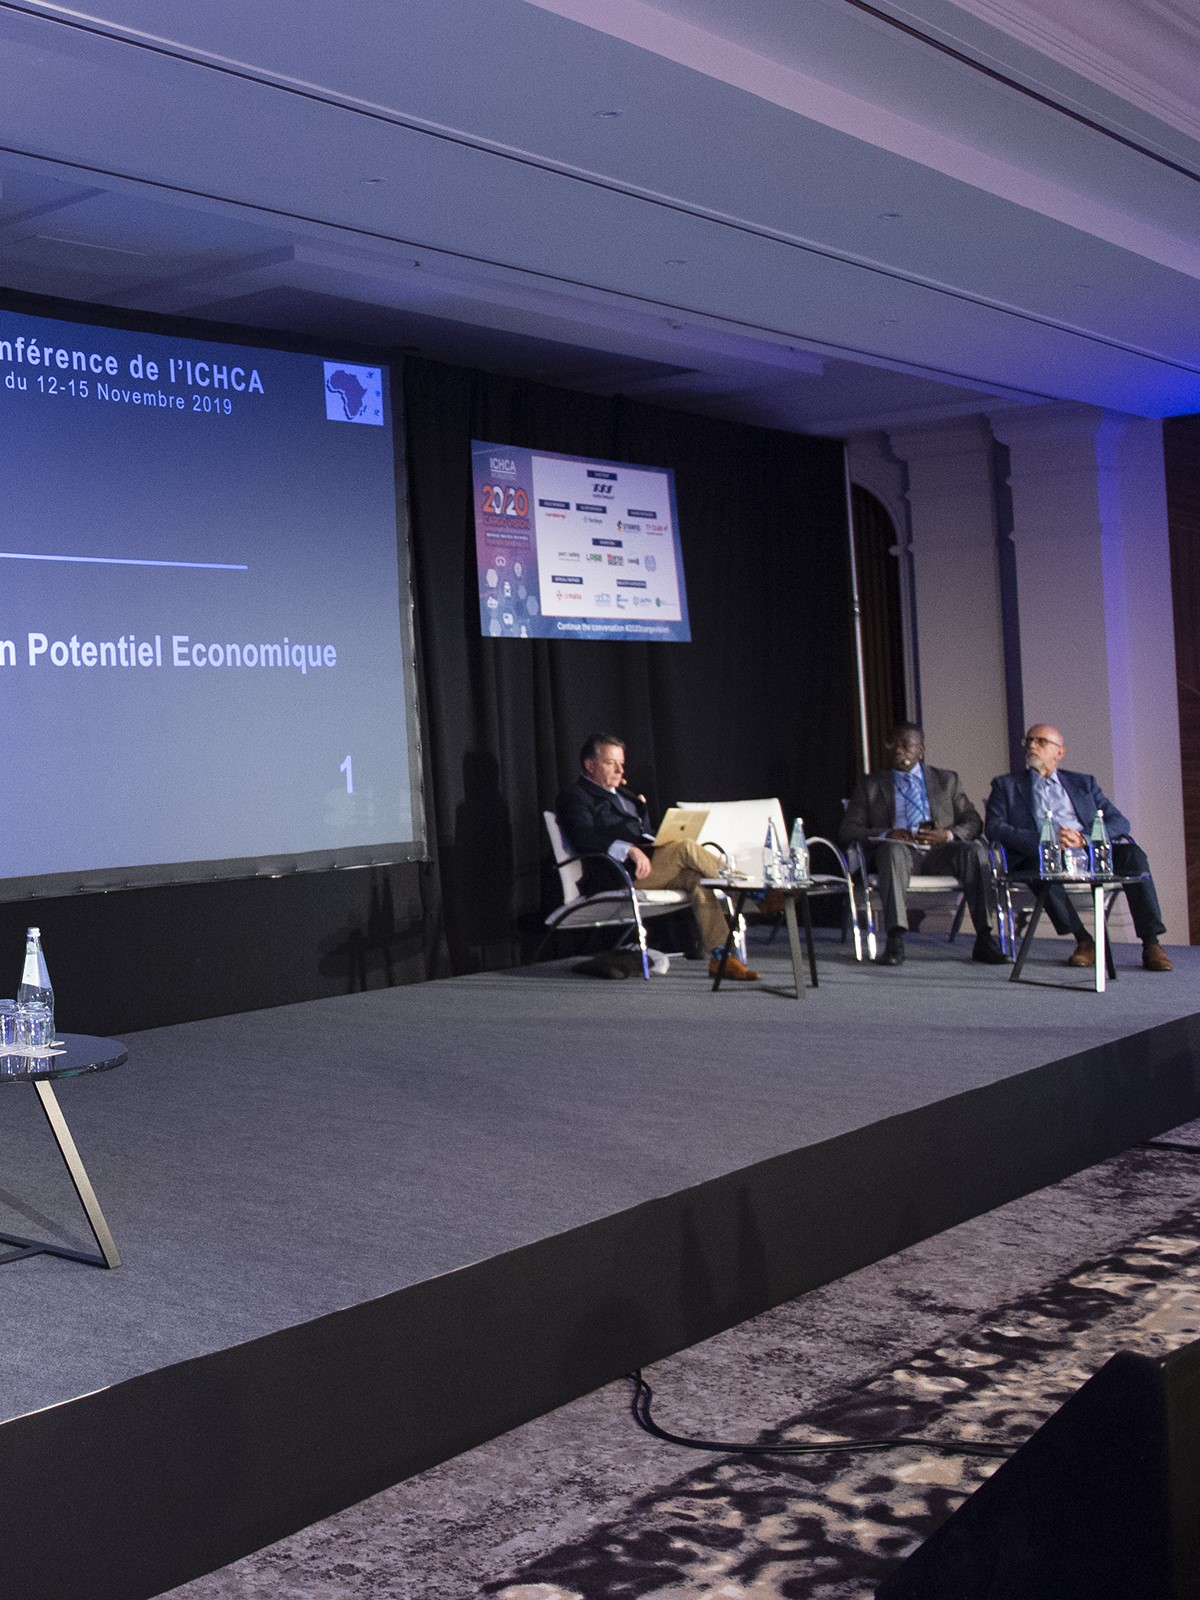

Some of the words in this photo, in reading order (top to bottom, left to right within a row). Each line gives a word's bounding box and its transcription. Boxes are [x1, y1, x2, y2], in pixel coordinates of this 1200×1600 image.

[129, 354, 159, 381] de
[5, 372, 27, 391] du
[37, 375, 89, 398] 12-15
[97, 382, 185, 410] Novembre
[193, 395, 232, 414] 2019
[490, 457, 516, 472] ICHCA
[483, 485, 529, 517] 20/20
[28, 632, 162, 666] Potentiel
[172, 635, 337, 675] Economique
[340, 754, 353, 794] 1
